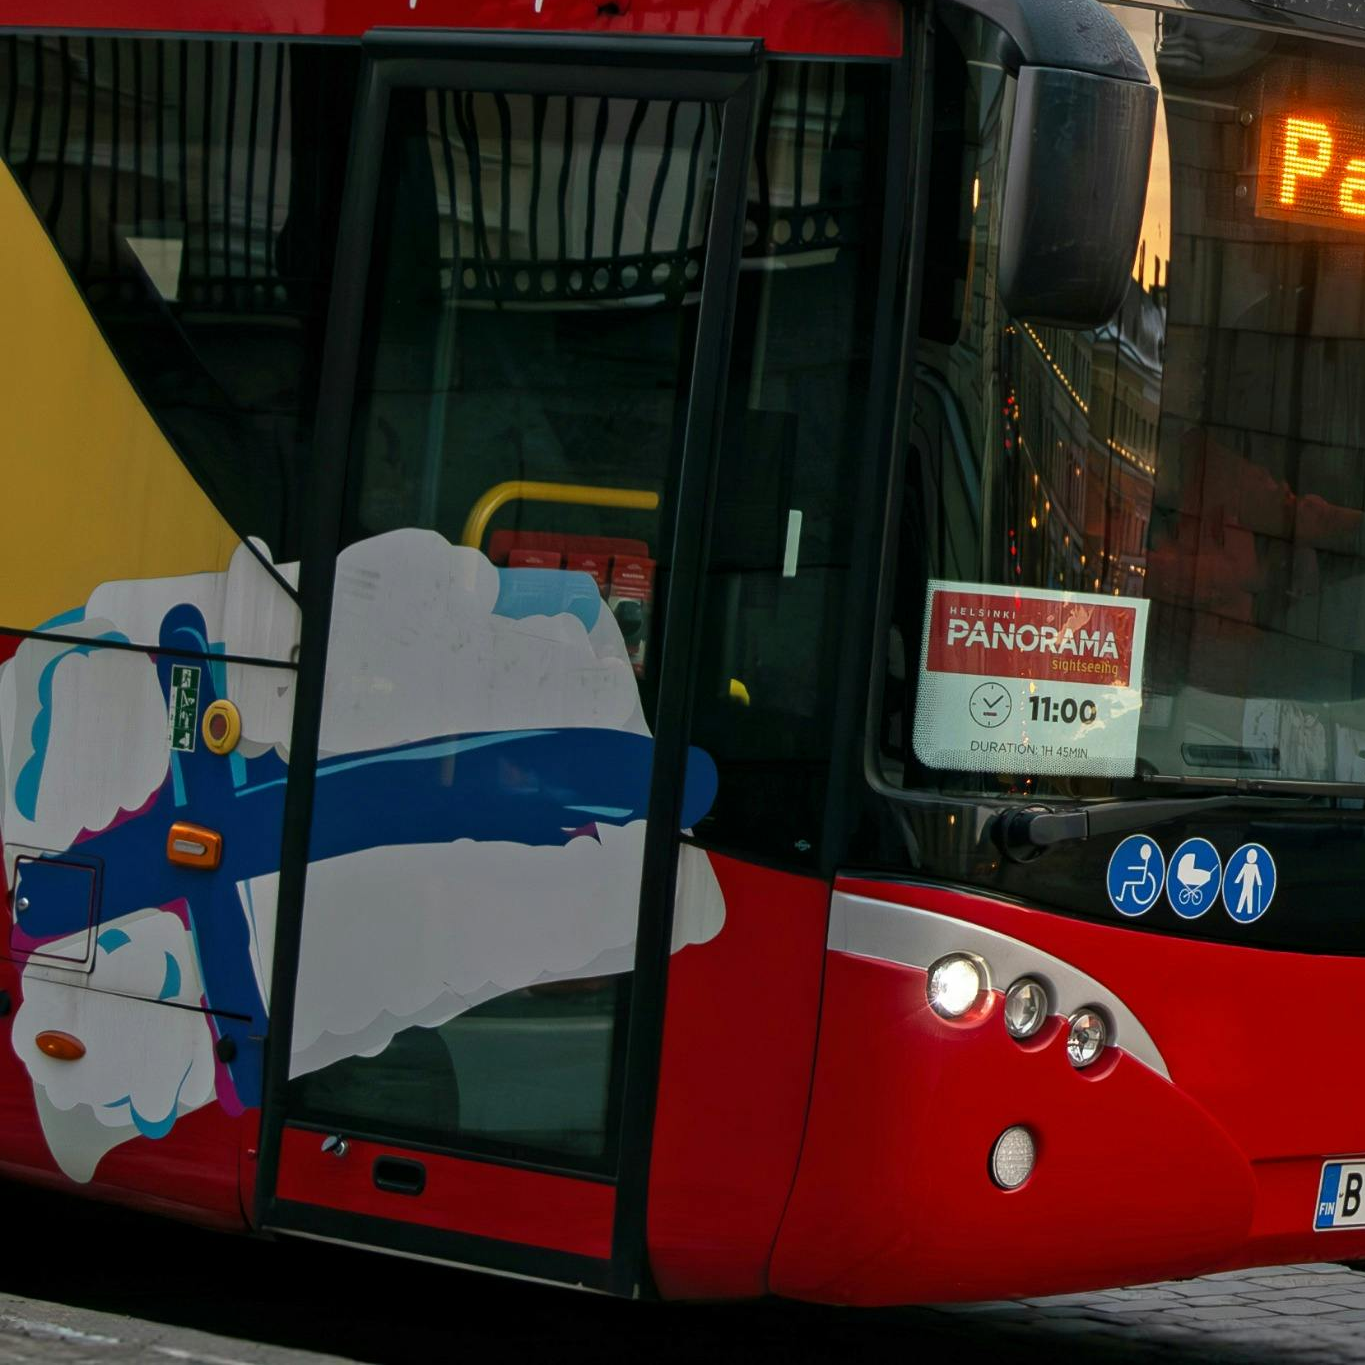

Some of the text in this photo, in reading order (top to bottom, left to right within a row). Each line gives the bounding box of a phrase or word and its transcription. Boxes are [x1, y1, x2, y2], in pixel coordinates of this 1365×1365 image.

[949, 606, 1016, 619] HELSINKI
[947, 619, 1119, 659] PANORAMA
[1029, 696, 1096, 725] 11:00
[970, 740, 1088, 759] DURATION: 1H 45MIN
[1319, 1202, 1334, 1216] FIN
